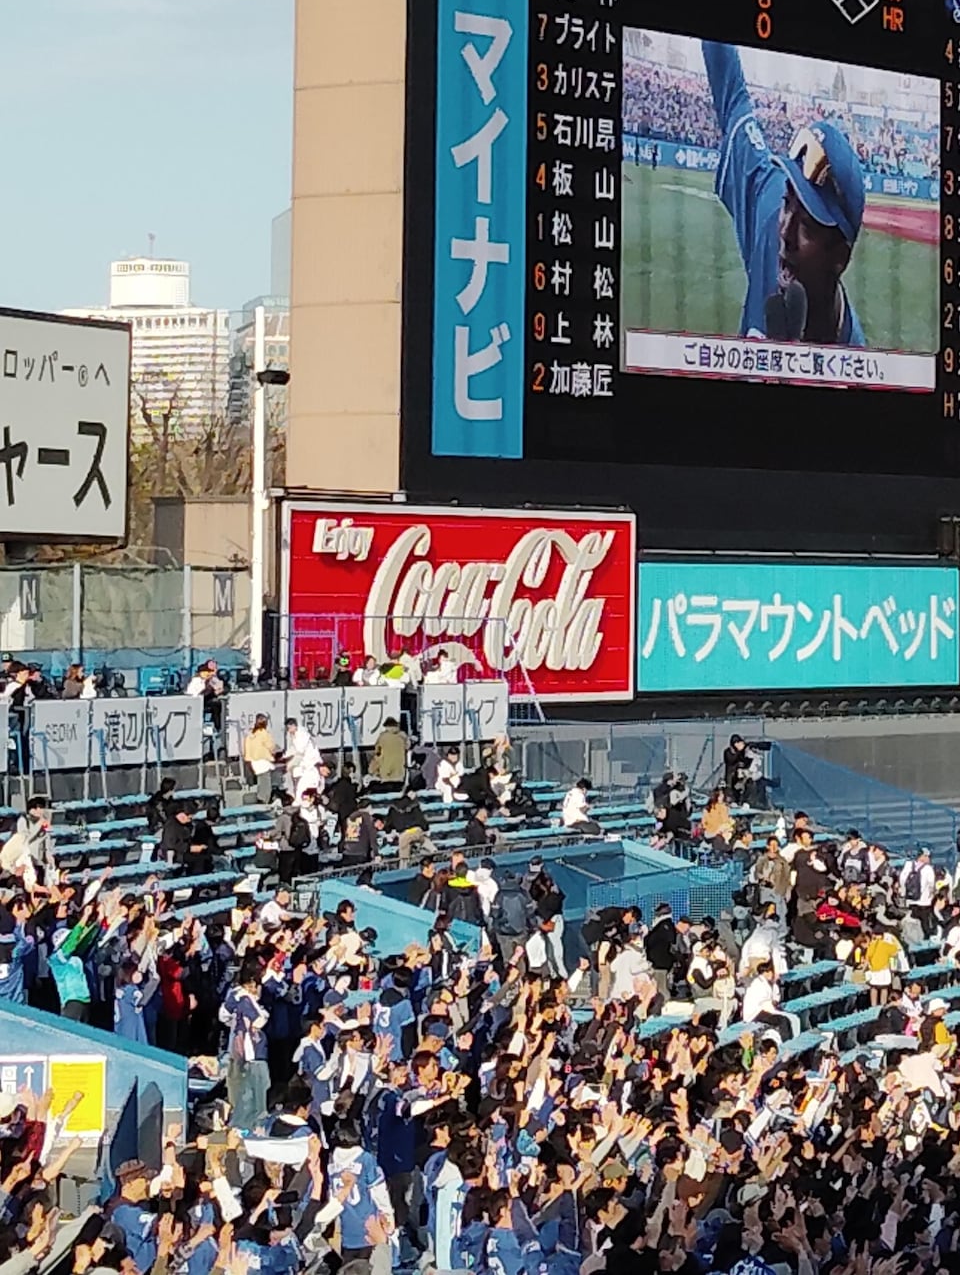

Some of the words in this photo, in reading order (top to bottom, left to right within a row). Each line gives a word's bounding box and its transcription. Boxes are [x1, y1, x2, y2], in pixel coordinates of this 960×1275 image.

[537, 13, 548, 41] 7
[554, 12, 616, 53] ブライト
[883, 5, 904, 32] HR
[944, 39, 954, 64] 4
[537, 63, 548, 91] 3
[553, 62, 616, 103] カリステ
[945, 82, 953, 108] 5
[536, 113, 547, 141] 5
[553, 113, 616, 152] 石川昂
[944, 127, 953, 152] 7
[536, 162, 546, 191] 4
[944, 170, 953, 197] 3
[451, 11, 513, 422] マイナビ
[537, 213, 544, 241] 1
[944, 214, 953, 241] 8
[534, 262, 546, 291] 6
[944, 258, 953, 286] 6
[534, 312, 545, 341] 9
[944, 303, 953, 330] 2
[683, 342, 885, 380] ご自分のお座席でご覧ください。
[944, 347, 953, 374] 9
[532, 362, 544, 392] 2
[549, 360, 614, 398] 加藤匠
[943, 392, 953, 418] H
[312, 518, 374, 561] Enjoy
[22, 579, 38, 615] N
[214, 578, 232, 614] M
[363, 524, 616, 672] Coca-Cola
[643, 591, 957, 663] パラマウントベッド
